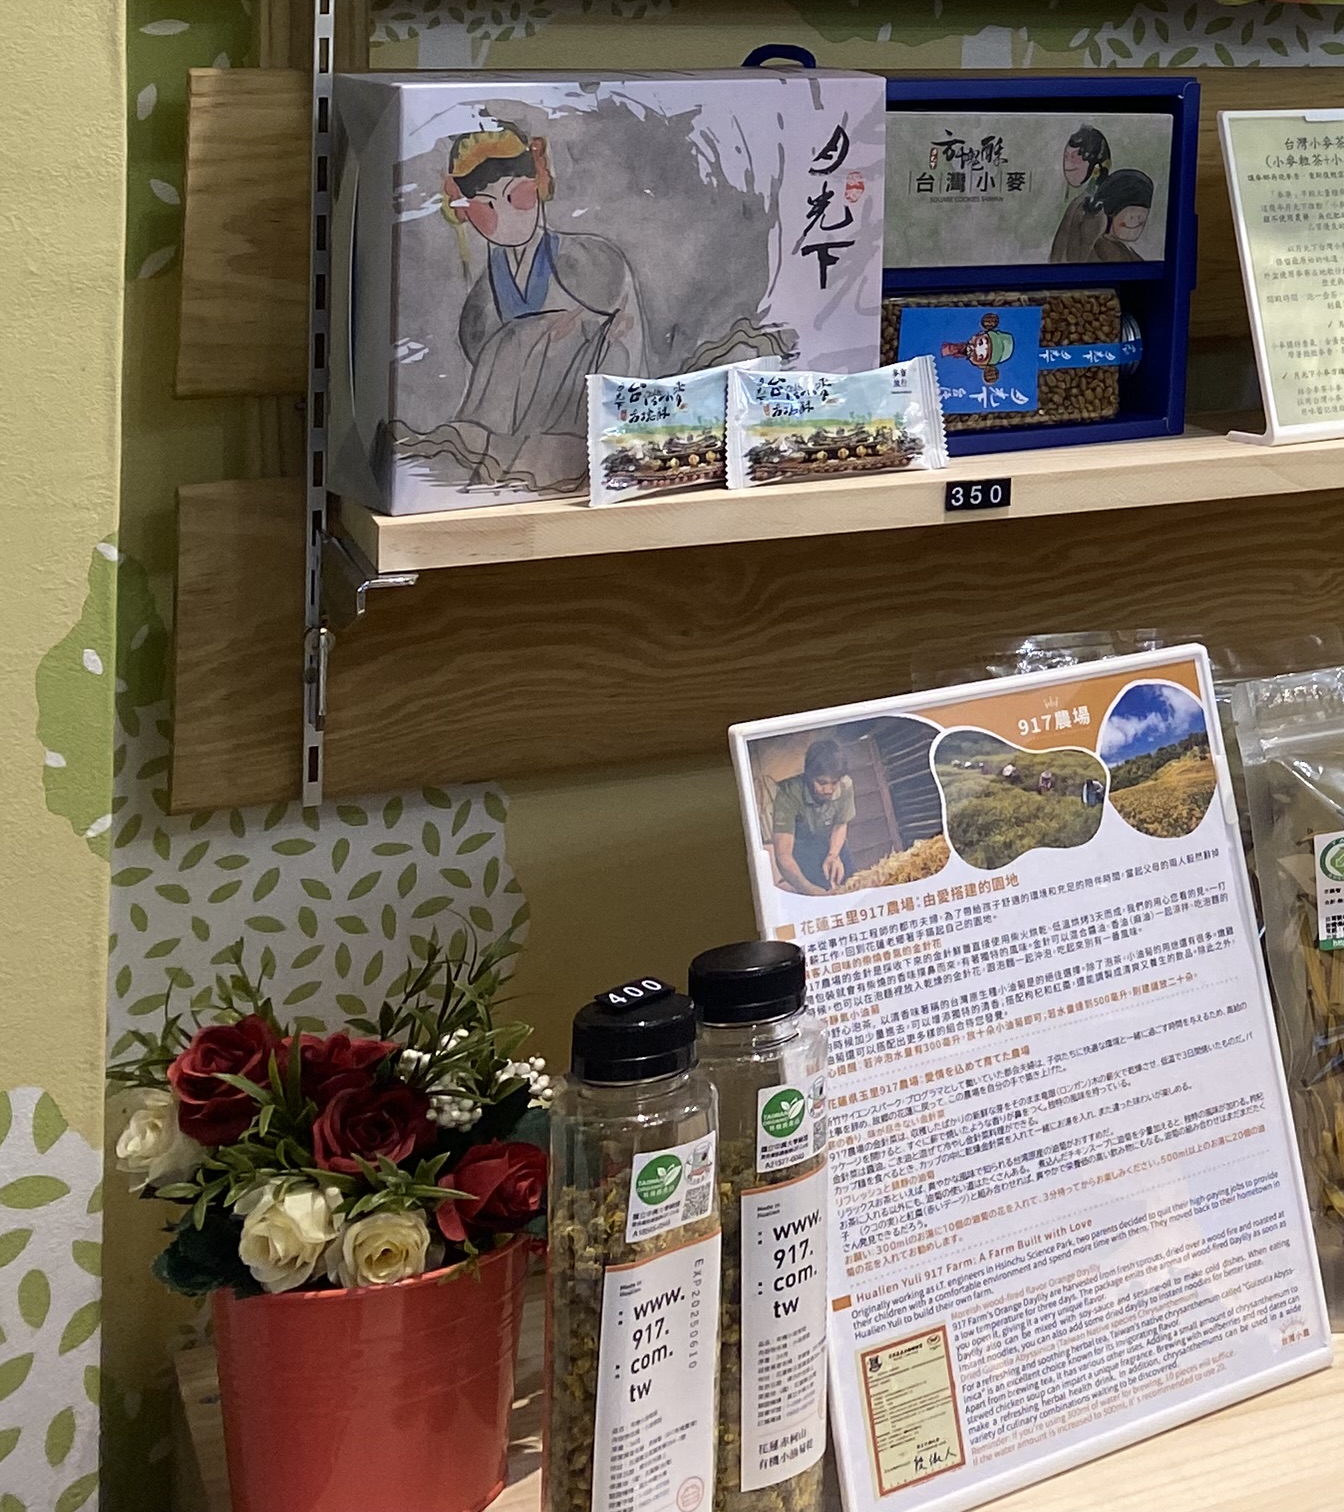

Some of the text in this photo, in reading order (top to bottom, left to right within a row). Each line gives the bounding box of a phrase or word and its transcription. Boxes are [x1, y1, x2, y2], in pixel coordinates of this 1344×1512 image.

[915, 171, 1026, 194] 台灣小麥
[801, 124, 855, 289] 月光下
[951, 483, 1002, 506] 350
[1017, 705, 1091, 736] 917農場
[607, 978, 664, 1008] 400
[773, 1209, 822, 1241] www.
[774, 1238, 814, 1269] 917.
[924, 1266, 943, 1280] 917
[945, 1255, 977, 1274] Farm:
[978, 1252, 985, 1262] A
[988, 1243, 1015, 1259] Farm
[1016, 1233, 1042, 1250] Built
[1043, 1225, 1067, 1241] with
[1068, 1217, 1092, 1233] Love
[773, 1264, 818, 1292] com.
[633, 1287, 685, 1321] www.
[773, 1297, 799, 1319] tw
[632, 1317, 670, 1350] 917.
[630, 1342, 674, 1374] com.
[629, 1380, 652, 1403] tw
